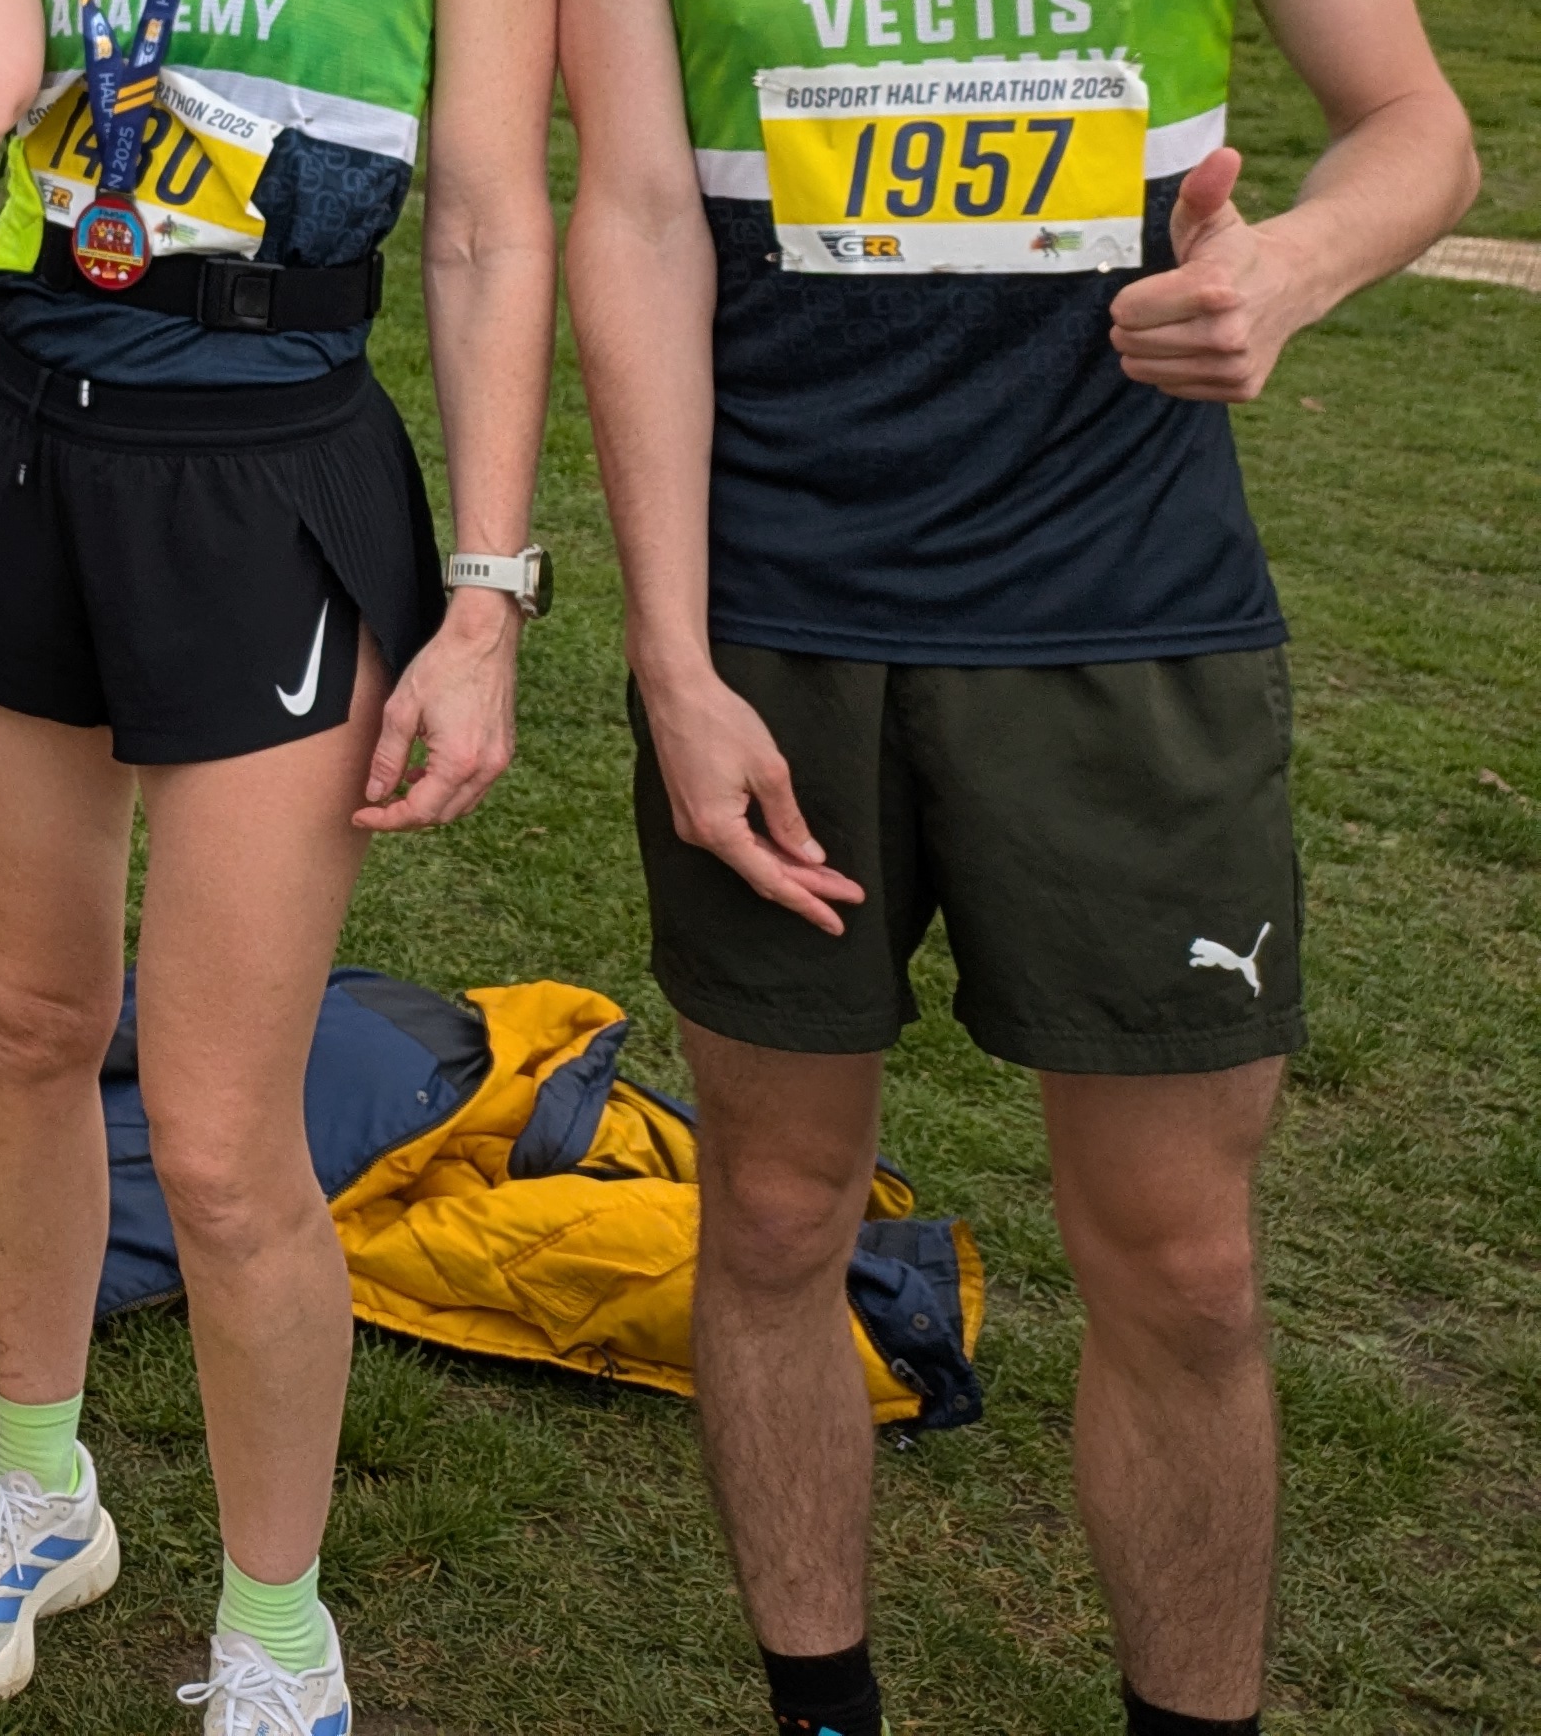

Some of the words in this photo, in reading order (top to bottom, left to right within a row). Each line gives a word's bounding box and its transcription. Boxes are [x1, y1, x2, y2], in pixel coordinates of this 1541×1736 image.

[156, 83, 206, 121] RATHON
[206, 109, 258, 140] 2025
[786, 84, 880, 108] GOSPORT
[886, 81, 938, 105] HALF
[945, 78, 1066, 104] MARATHON
[1072, 76, 1125, 100] 2025
[114, 126, 135, 169] 2025
[845, 117, 1075, 218] 1957
